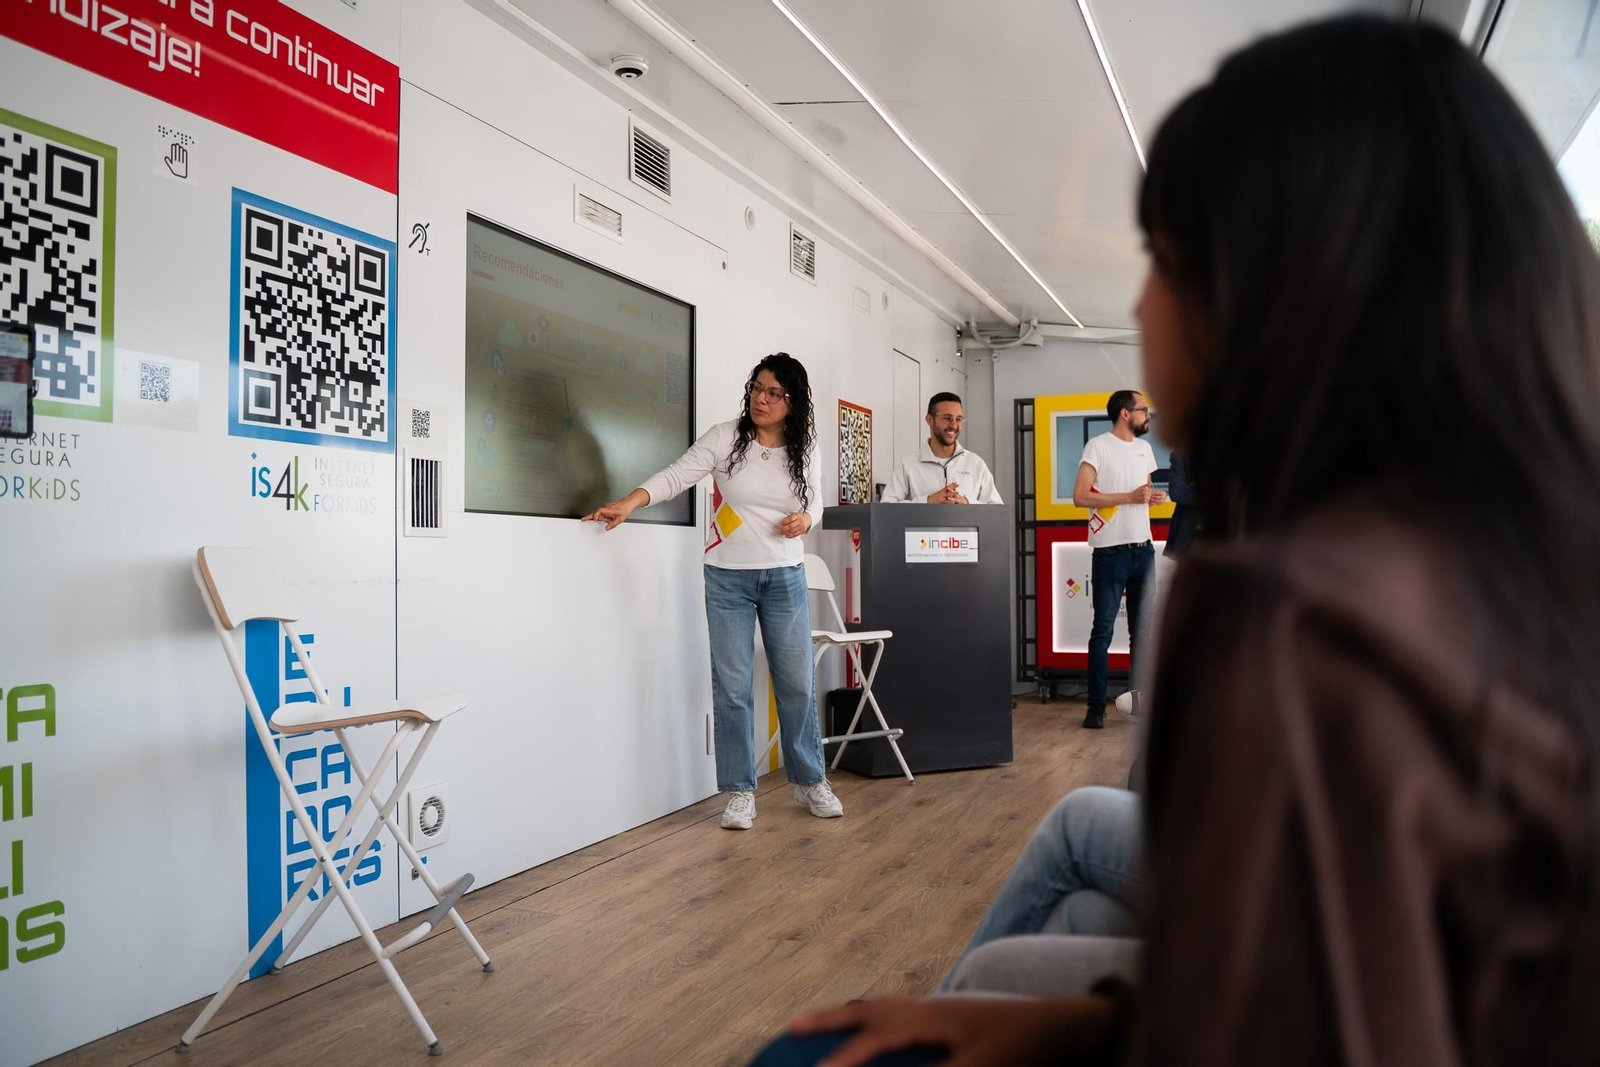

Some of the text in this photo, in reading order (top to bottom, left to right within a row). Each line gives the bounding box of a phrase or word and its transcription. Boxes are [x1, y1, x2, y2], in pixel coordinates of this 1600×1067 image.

[26, 0, 200, 77] dizaje!
[226, 9, 384, 107] continuar
[473, 243, 565, 290] Recomendaciones
[314, 457, 376, 476] INTERNET
[319, 473, 371, 489] SEGURA
